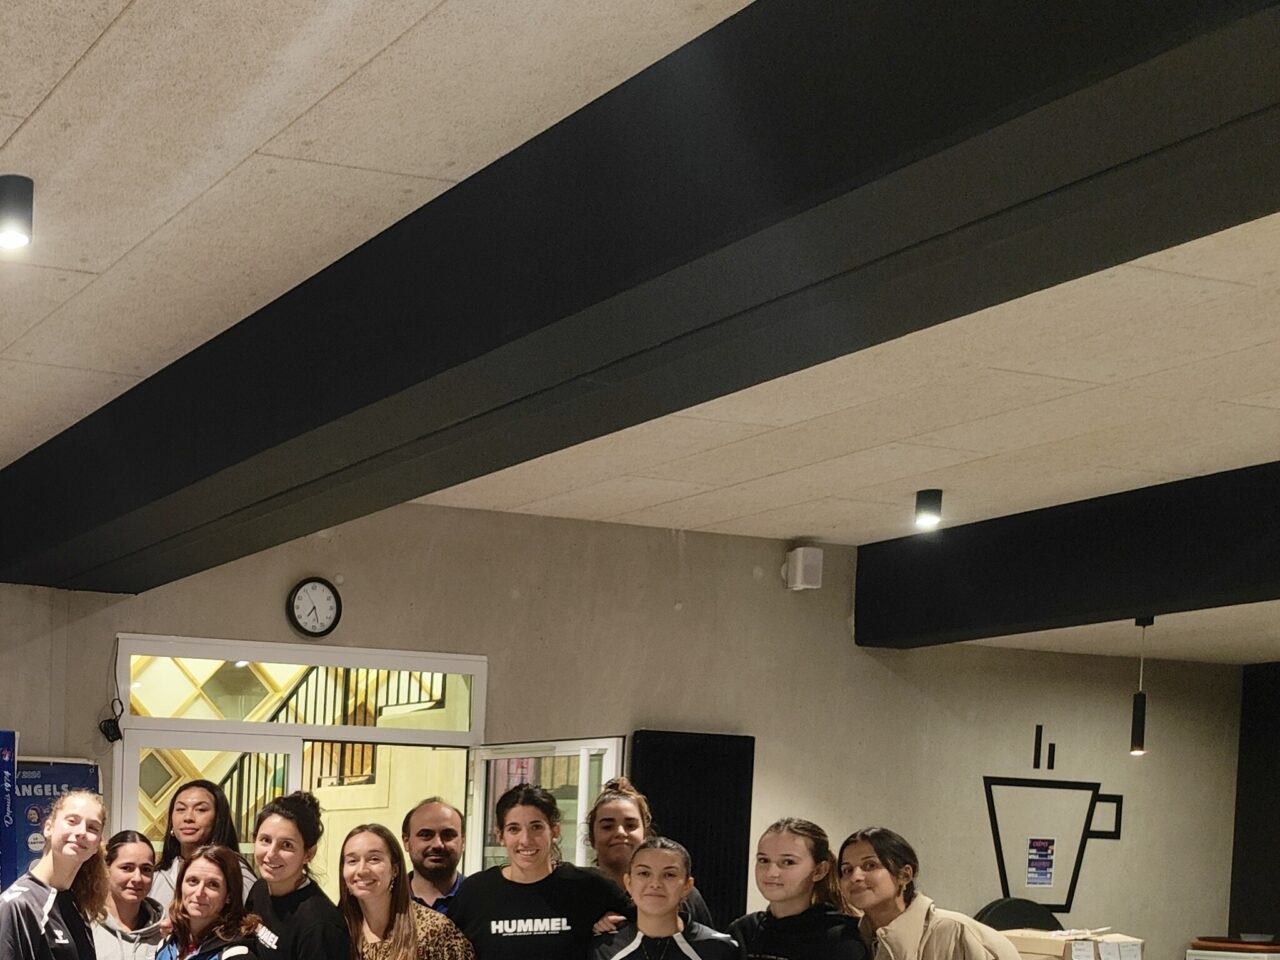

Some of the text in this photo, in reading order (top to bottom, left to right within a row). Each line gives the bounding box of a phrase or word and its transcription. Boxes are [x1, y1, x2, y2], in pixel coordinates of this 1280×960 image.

[4, 770, 14, 828] Depuis 1974
[490, 917, 572, 934] HUMMEL
